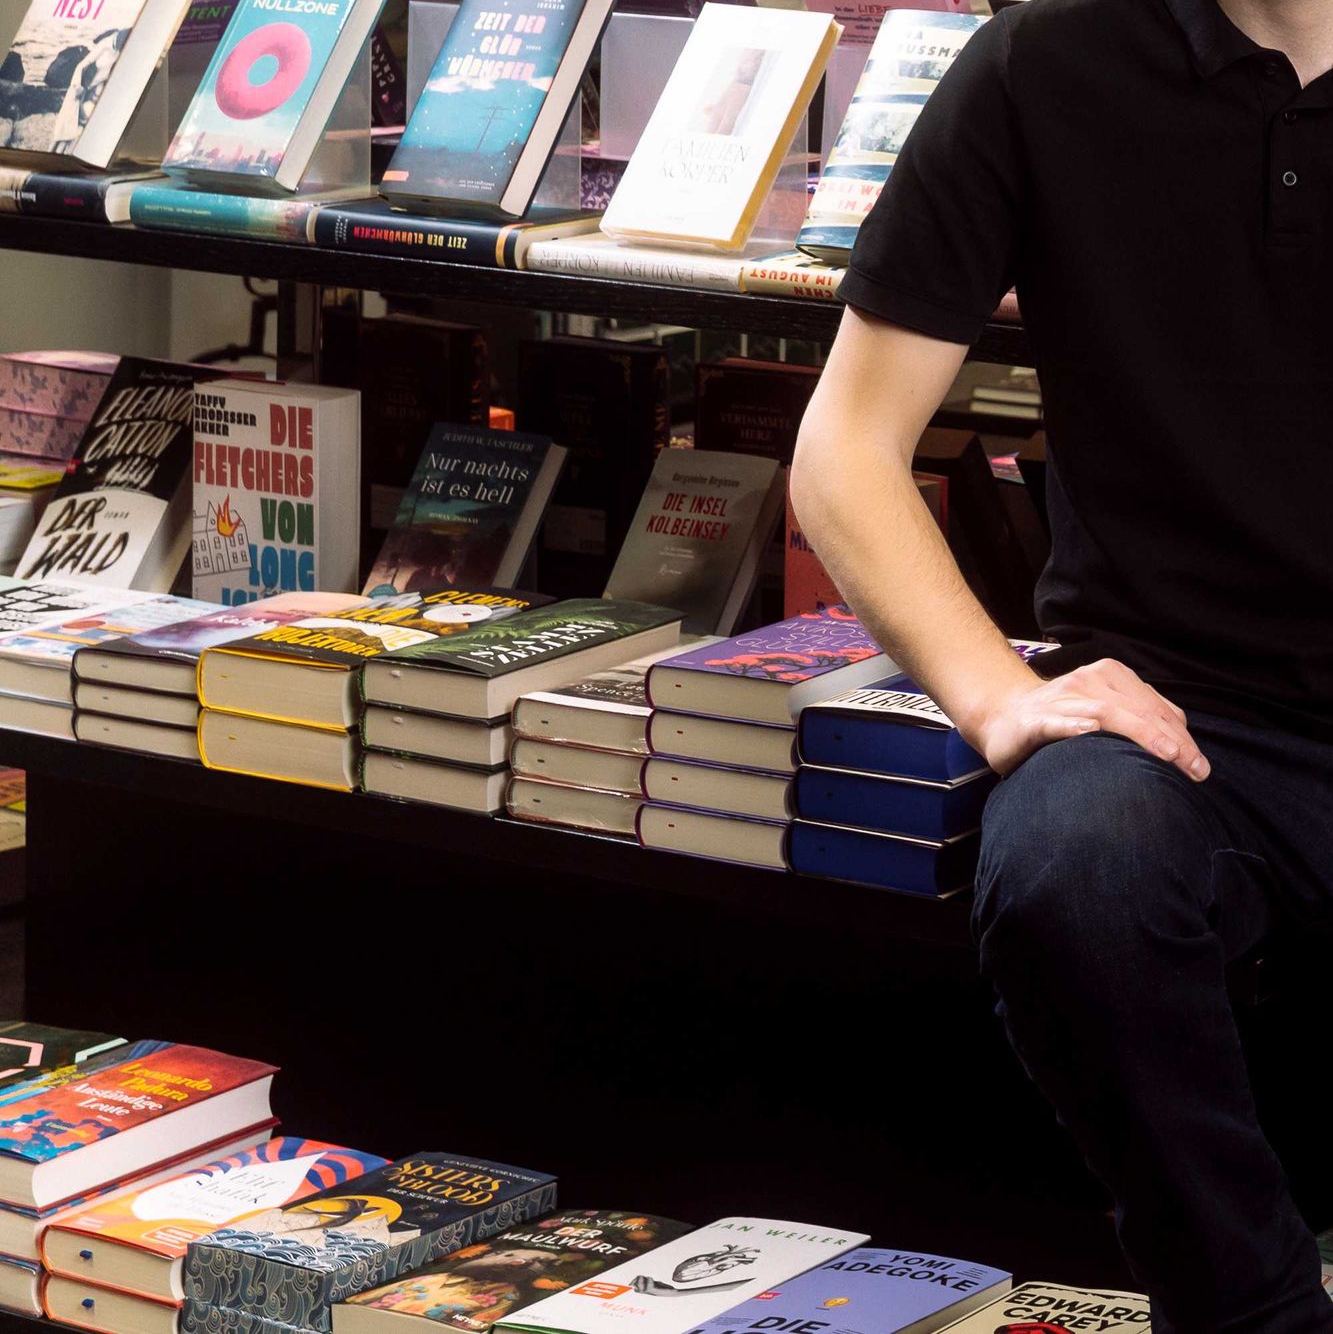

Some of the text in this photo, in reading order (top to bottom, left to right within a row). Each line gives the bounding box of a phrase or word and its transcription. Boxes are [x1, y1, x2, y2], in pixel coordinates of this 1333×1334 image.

[474, 12, 547, 35] ZEIT DER
[427, 232, 445, 247] DER
[448, 235, 467, 250] ZEIT
[750, 268, 833, 286] IM AUGUST
[793, 286, 835, 300] CHEN
[194, 392, 226, 407] TAFFY
[269, 403, 313, 450] DIE
[84, 423, 183, 463] CATTON
[194, 441, 314, 498] FLETCHERS
[425, 452, 529, 482] Nur nachts
[421, 475, 515, 505] ist es hell
[43, 496, 107, 535] DER
[662, 492, 729, 517] DIE INSEL
[260, 497, 314, 546] VON
[646, 515, 731, 541] KOLBEINSEY
[22, 532, 130, 580] WALD
[248, 543, 314, 591] LONG
[423, 590, 531, 609] CLEMENS
[253, 625, 382, 658] PROJEKTOREN
[118, 1063, 213, 1092] Leonardo
[118, 1077, 189, 1102] Padura
[66, 1083, 164, 1111] Anständige
[78, 1097, 130, 1116] Leute
[497, 1231, 628, 1256] MAULWURF
[553, 1226, 603, 1240] DER
[708, 1222, 849, 1246] JAN WEILER
[889, 1254, 956, 1271] YOMI
[822, 1260, 980, 1292] ADEGOKE
[600, 1301, 649, 1316] MUNK
[1003, 1306, 1124, 1332] CAREY
[1005, 1292, 1150, 1323] EDWARD
[748, 1316, 831, 1334] DIE
